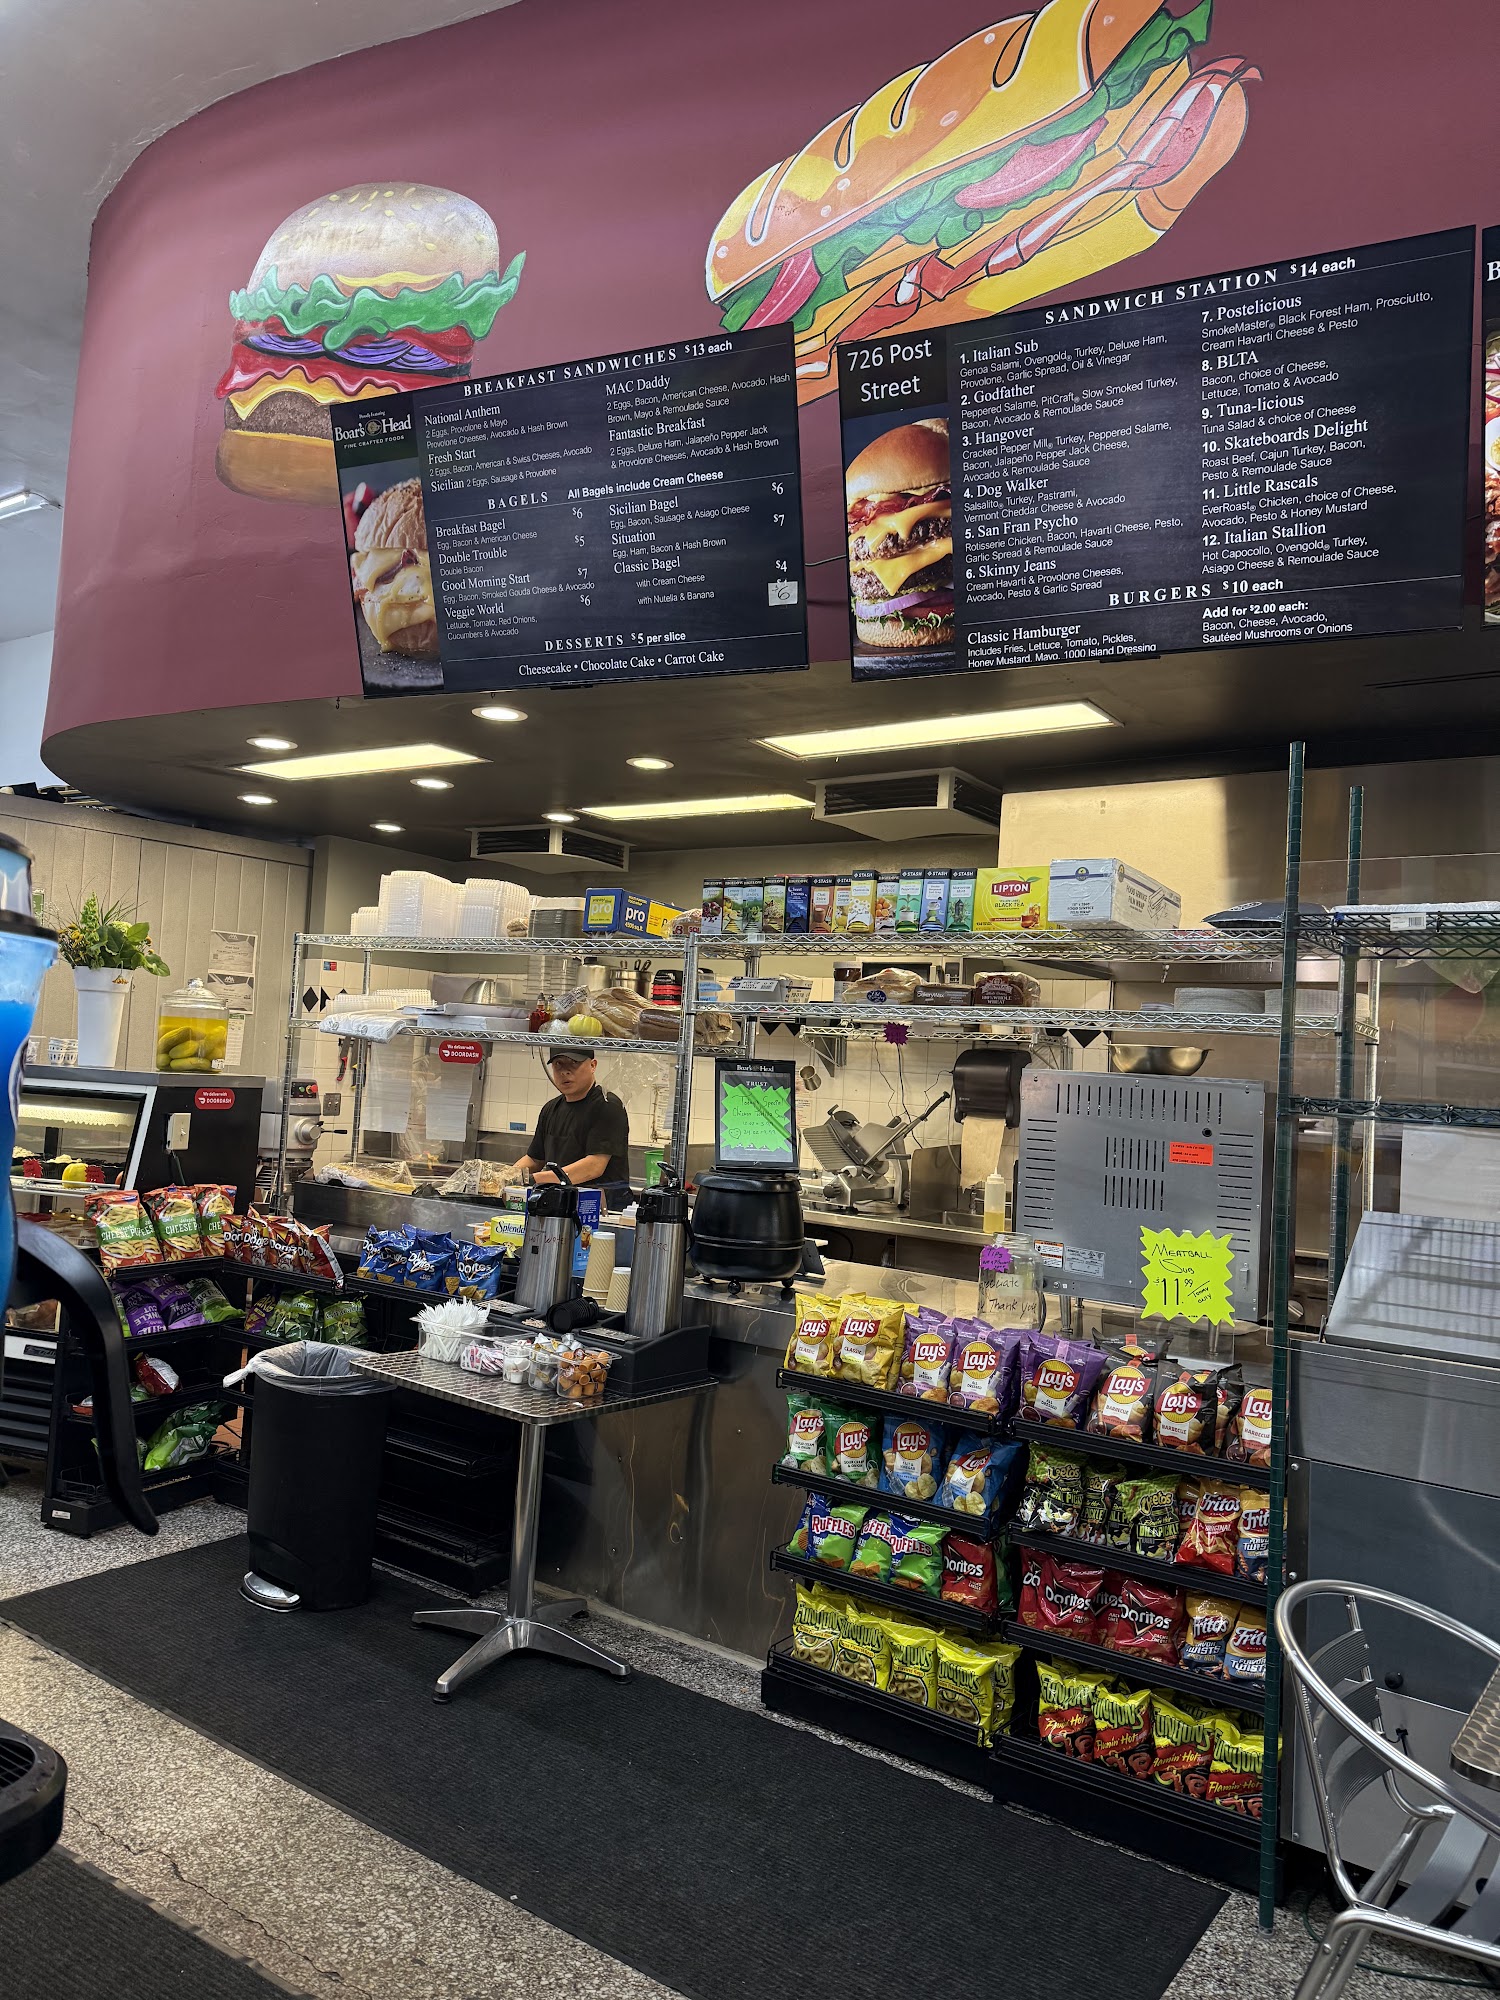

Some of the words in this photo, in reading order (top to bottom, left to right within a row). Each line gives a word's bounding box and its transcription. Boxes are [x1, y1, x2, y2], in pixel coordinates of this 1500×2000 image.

[1045, 289, 1164, 324] SANDWICH
[1175, 268, 1277, 300] STATION
[1289, 260, 1318, 277] $14
[1321, 256, 1355, 274] each
[1201, 310, 1213, 323] 7.
[1216, 296, 1301, 320] Postelicious
[846, 346, 883, 371] 726
[889, 339, 932, 363] Post
[959, 353, 969, 364] 1.
[973, 346, 1010, 362] Italian
[1014, 338, 1038, 354] Sub
[1201, 359, 1213, 371] 8.
[1216, 350, 1259, 369] BLTA
[463, 369, 556, 397] BREAKFAST
[563, 348, 676, 379] SANDWICHES
[684, 343, 705, 356] $13
[707, 340, 732, 354] each
[606, 380, 633, 396] MAC
[637, 375, 670, 390] Daddy
[606, 401, 611, 410] 2
[612, 400, 633, 410] Eggs,
[634, 395, 660, 406] Bacon,
[661, 389, 697, 401] American
[698, 384, 729, 395] Cheese,
[731, 377, 767, 390] Avocado,
[769, 372, 790, 384] Hash
[860, 375, 920, 402] Street
[960, 394, 970, 405] 2.
[973, 383, 1035, 403] Godfather
[423, 408, 462, 426] National
[463, 405, 500, 419] Anthem
[1201, 407, 1213, 419] 9.
[1216, 395, 1304, 416] Tuna-licious
[334, 422, 366, 441] Boar's
[381, 414, 412, 434] Head
[608, 426, 653, 441] Fantastic
[656, 417, 705, 434] Breakfast
[961, 435, 972, 446] 3.
[974, 426, 1034, 444] Hangover
[1201, 440, 1220, 453] 10.
[1224, 426, 1309, 450] Skateboards
[1313, 418, 1368, 438] Delight
[358, 438, 384, 447] CRAFTED
[385, 434, 405, 443] FOODS
[428, 450, 452, 464] Fresh
[454, 448, 476, 460] Start
[430, 479, 465, 492] Sicilian
[567, 487, 580, 499] All
[581, 484, 613, 498] Bagels
[615, 479, 650, 492] include
[652, 476, 684, 487] Cream
[686, 470, 723, 483] Cheese
[771, 481, 783, 495] $6
[963, 487, 973, 498] 4.
[976, 484, 1002, 498] Dog
[1005, 476, 1048, 492] Walker
[1202, 487, 1220, 500] 11.
[1223, 480, 1260, 497] Little
[1264, 473, 1318, 492] Rascals
[487, 491, 547, 509] BAGELS
[608, 501, 646, 515] Sicilian
[649, 495, 678, 512] Bagel
[571, 506, 583, 519] $6
[773, 513, 784, 526] $7
[435, 522, 477, 537] Breakfast
[479, 517, 505, 533] Bagel
[964, 528, 974, 539] 5.
[977, 524, 999, 537] San
[1002, 521, 1030, 534] Fran
[1033, 513, 1078, 532] Psycho
[1202, 534, 1220, 546] 12.
[1224, 528, 1267, 544] Italian
[1271, 522, 1326, 538] Stallion
[574, 534, 585, 547] $5
[611, 531, 655, 545] Situation
[438, 550, 470, 564] Double
[471, 546, 507, 560] Trouble
[613, 561, 649, 573] Classic
[651, 555, 680, 571] Bagel
[577, 567, 587, 579] $7
[775, 559, 787, 572] $4
[965, 568, 975, 579] 6.
[978, 564, 1020, 577] Skinny
[1023, 559, 1056, 572] Jeans
[441, 578, 466, 591] Good
[467, 577, 507, 588] Morning
[508, 573, 530, 584] Start
[635, 578, 651, 587] with
[651, 577, 676, 586] Cream
[677, 574, 705, 583] Cheese
[579, 594, 590, 606] $6
[637, 595, 652, 604] with
[653, 593, 678, 603] Nutella
[679, 592, 685, 601] &
[686, 590, 714, 600] Banana
[1108, 584, 1211, 606] BURGERS
[1222, 580, 1248, 594] $10
[1252, 578, 1283, 591] each
[444, 607, 475, 619] Veggie
[476, 601, 504, 614] World
[1201, 605, 1228, 619] Add
[1231, 606, 1247, 616] for
[1249, 602, 1276, 614] $2.00
[1278, 600, 1308, 612] each:
[1202, 621, 1235, 631] Bacon,
[1238, 617, 1278, 628] Cheese,
[1280, 611, 1327, 624] Avocado,
[544, 633, 623, 651] DESSERTS
[630, 632, 644, 644] $5
[646, 635, 662, 646] per
[663, 631, 686, 642] slice
[967, 629, 1009, 644] Classic
[1012, 624, 1080, 640] Hamburger
[1202, 630, 1242, 643] Sautéed
[1244, 627, 1301, 639] Mushrooms
[1303, 626, 1314, 635] or
[1316, 623, 1353, 633] Onions
[518, 661, 571, 675] Cheesecake
[580, 658, 628, 671] Chocolate
[629, 655, 655, 667] Cake
[664, 653, 696, 665] Carrot
[698, 650, 724, 662] Cake
[993, 883, 1029, 893] LIPTON
[592, 902, 612, 915] pro
[625, 906, 646, 923] pro
[101, 1228, 130, 1241] CHEESE
[165, 1224, 193, 1235] CHEESE
[496, 1220, 525, 1234] Splenda
[1151, 1243, 1213, 1259] MEATBALL
[799, 1319, 827, 1338] Lay's
[843, 1318, 878, 1338] Lay's
[844, 1346, 862, 1355] CLASSIC
[914, 1342, 947, 1363] Lay's
[964, 1351, 996, 1372] Lay's
[1038, 1368, 1075, 1392] Lay's
[1108, 1375, 1144, 1397] Lay's
[1161, 1392, 1198, 1414] Lay's
[794, 1416, 824, 1435] Lay's
[839, 1428, 870, 1450] Lay's
[896, 1430, 927, 1452] Lay's
[1200, 1492, 1240, 1512] Fritos
[812, 1514, 856, 1538] RUFFLES
[890, 1535, 933, 1556] RUFFLES
[1045, 1585, 1092, 1610] Doritos
[1119, 1604, 1172, 1630] Doritos
[1070, 1714, 1088, 1726] Hot
[1120, 1733, 1138, 1743] Hot
[1182, 1750, 1200, 1762] Hot
[1208, 1781, 1241, 1793] Flamin'
